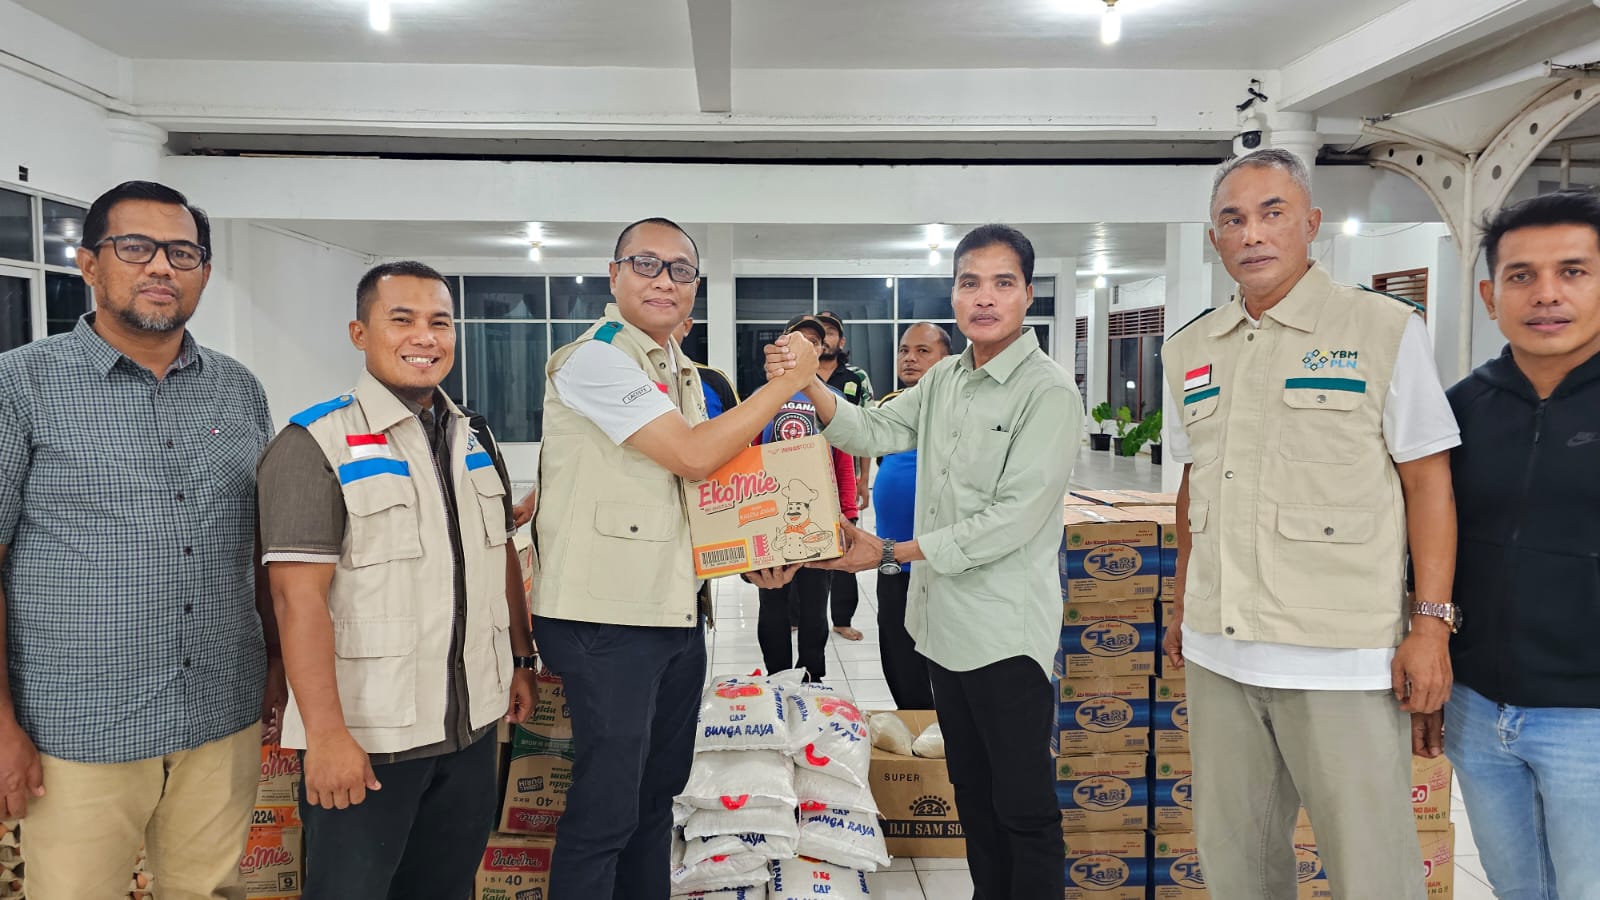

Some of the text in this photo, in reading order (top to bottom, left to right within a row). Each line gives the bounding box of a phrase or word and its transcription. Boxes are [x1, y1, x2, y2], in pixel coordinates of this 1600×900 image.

[1330, 350, 1358, 360] YBM
[1330, 359, 1358, 369] PLN
[780, 401, 816, 412] AGANA
[698, 470, 779, 508] EkoMie
[729, 714, 747, 722] CAP
[704, 723, 774, 738] BUNGA RAYA
[261, 755, 303, 776] oMie
[884, 773, 920, 782] SUPER
[536, 796, 553, 807] 40
[917, 803, 942, 814] 234
[250, 809, 275, 824] 224
[1413, 811, 1446, 820] NING!!
[847, 820, 875, 838] RAYA
[889, 823, 965, 836] DJI SAM SO
[283, 877, 294, 889] 9
[505, 875, 522, 886] 40
[813, 884, 831, 894] CAP
